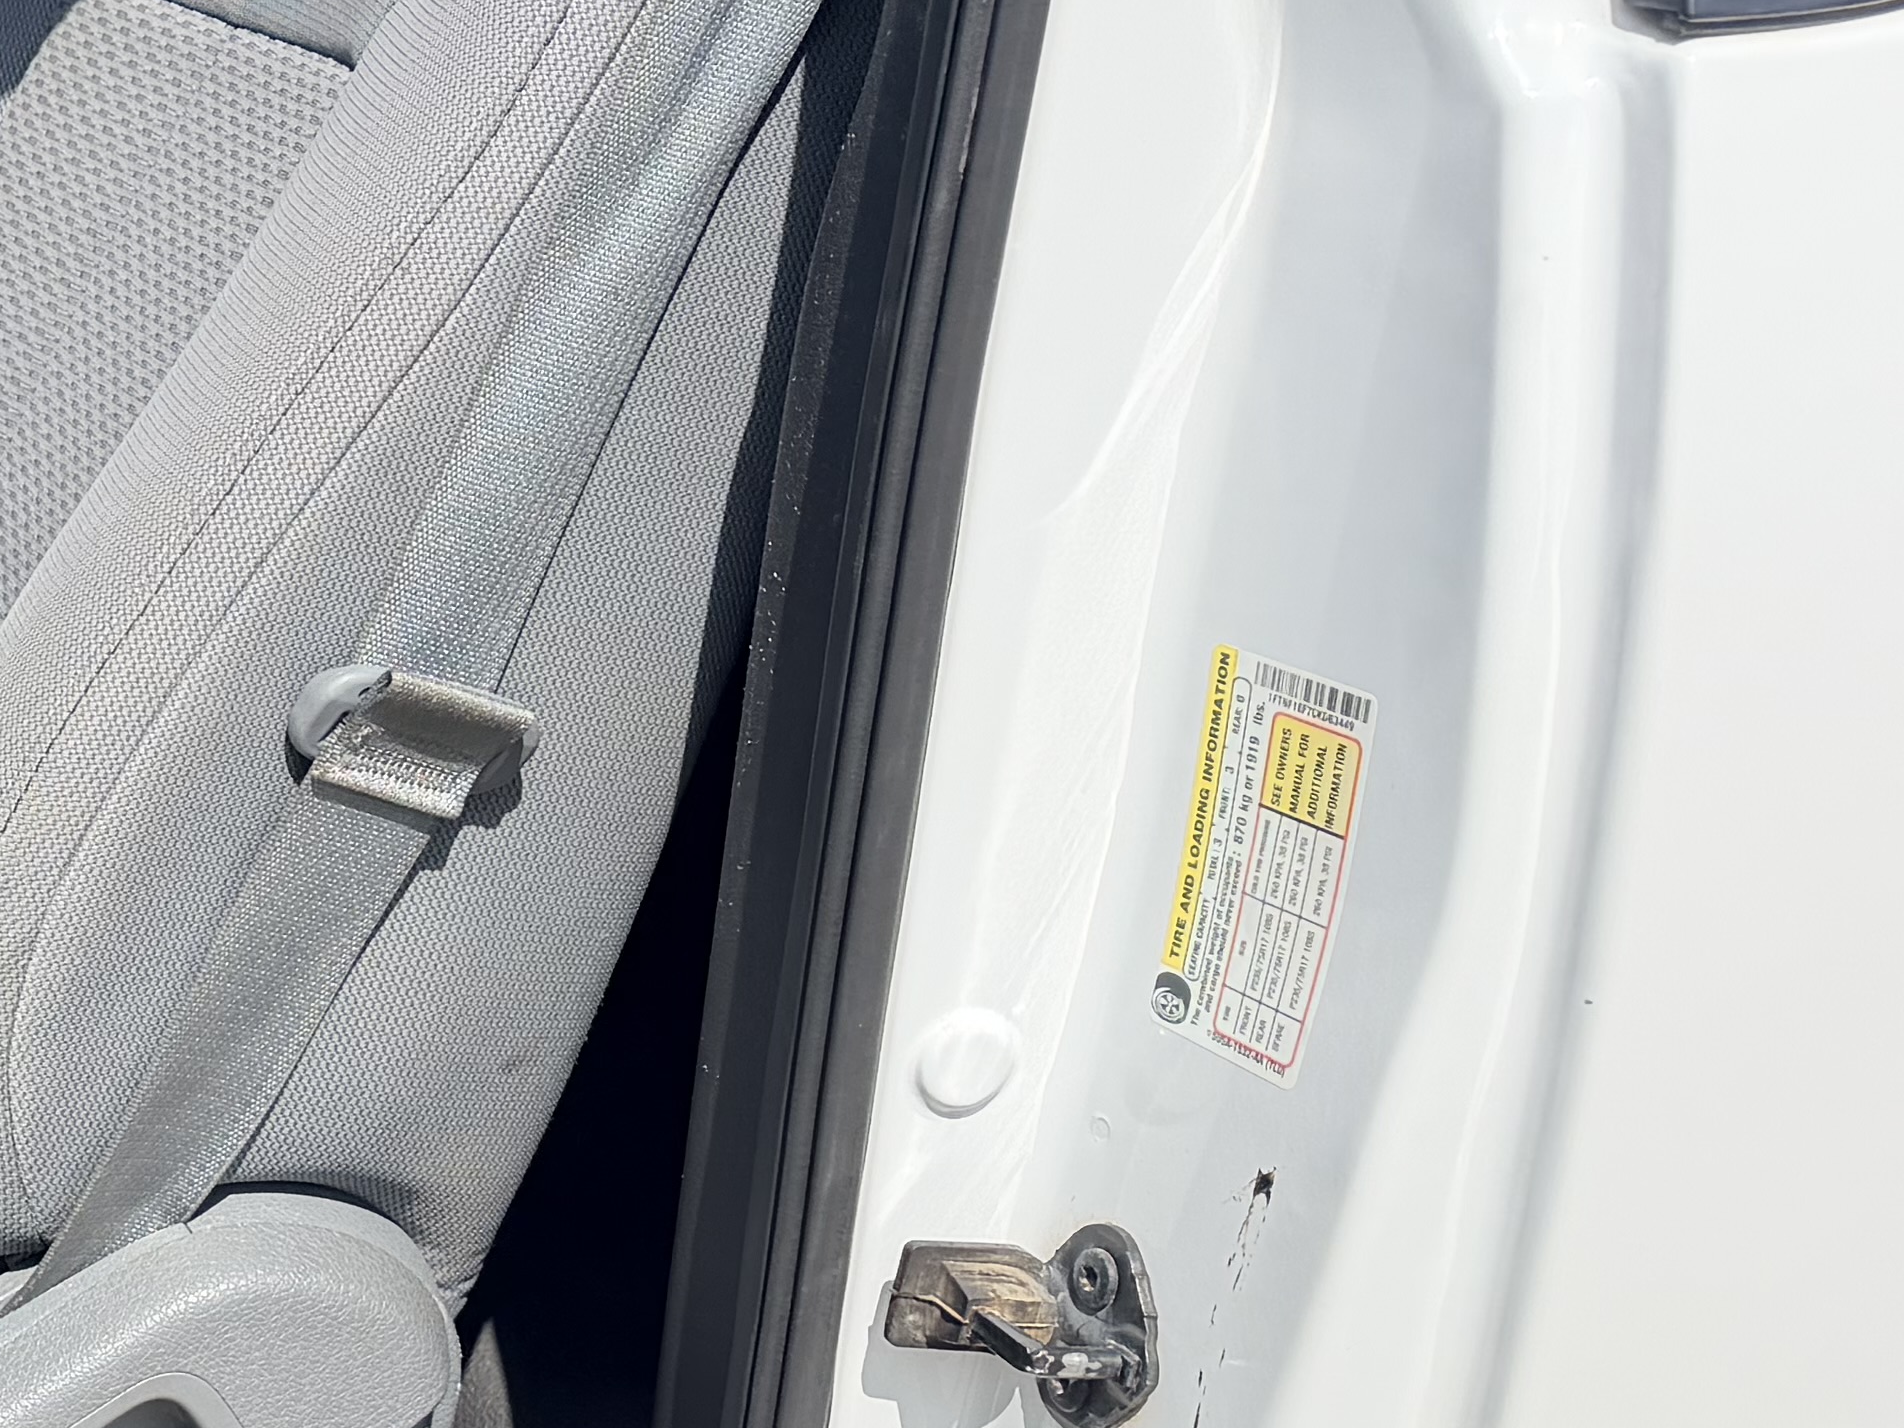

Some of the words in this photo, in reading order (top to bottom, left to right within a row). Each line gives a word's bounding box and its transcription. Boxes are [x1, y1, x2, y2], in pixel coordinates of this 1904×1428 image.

[1202, 652, 1231, 782] INFORMATION
[1253, 702, 1266, 726] lbs.
[1245, 735, 1260, 771] 1919
[1275, 727, 1292, 780] OWNERS
[1244, 775, 1254, 790] or
[1289, 764, 1305, 813] MANUAL
[1298, 733, 1310, 758] FOR
[1307, 747, 1328, 819] ADDITIONAL
[1325, 743, 1347, 830] INFORMATION
[1238, 793, 1254, 812] kg
[1271, 783, 1283, 806] SEE
[1187, 787, 1210, 869] LOADING
[1233, 816, 1248, 845] 870
[1180, 874, 1195, 914] AND
[1224, 898, 1234, 926] never
[1169, 917, 1187, 957] TIRE
[1188, 940, 1202, 976] SEATING
[1196, 898, 1210, 939] CAPACITY
[1190, 1008, 1201, 1026] The
[1196, 958, 1213, 1006] combined
[1208, 922, 1221, 955] weight
[1219, 856, 1234, 907] occupants
[1215, 928, 1229, 962] should
[1210, 963, 1222, 992] cargo
[1204, 993, 1214, 1013] and
[1239, 1005, 1252, 1035] FRONT
[1255, 1019, 1266, 1043] REAR
